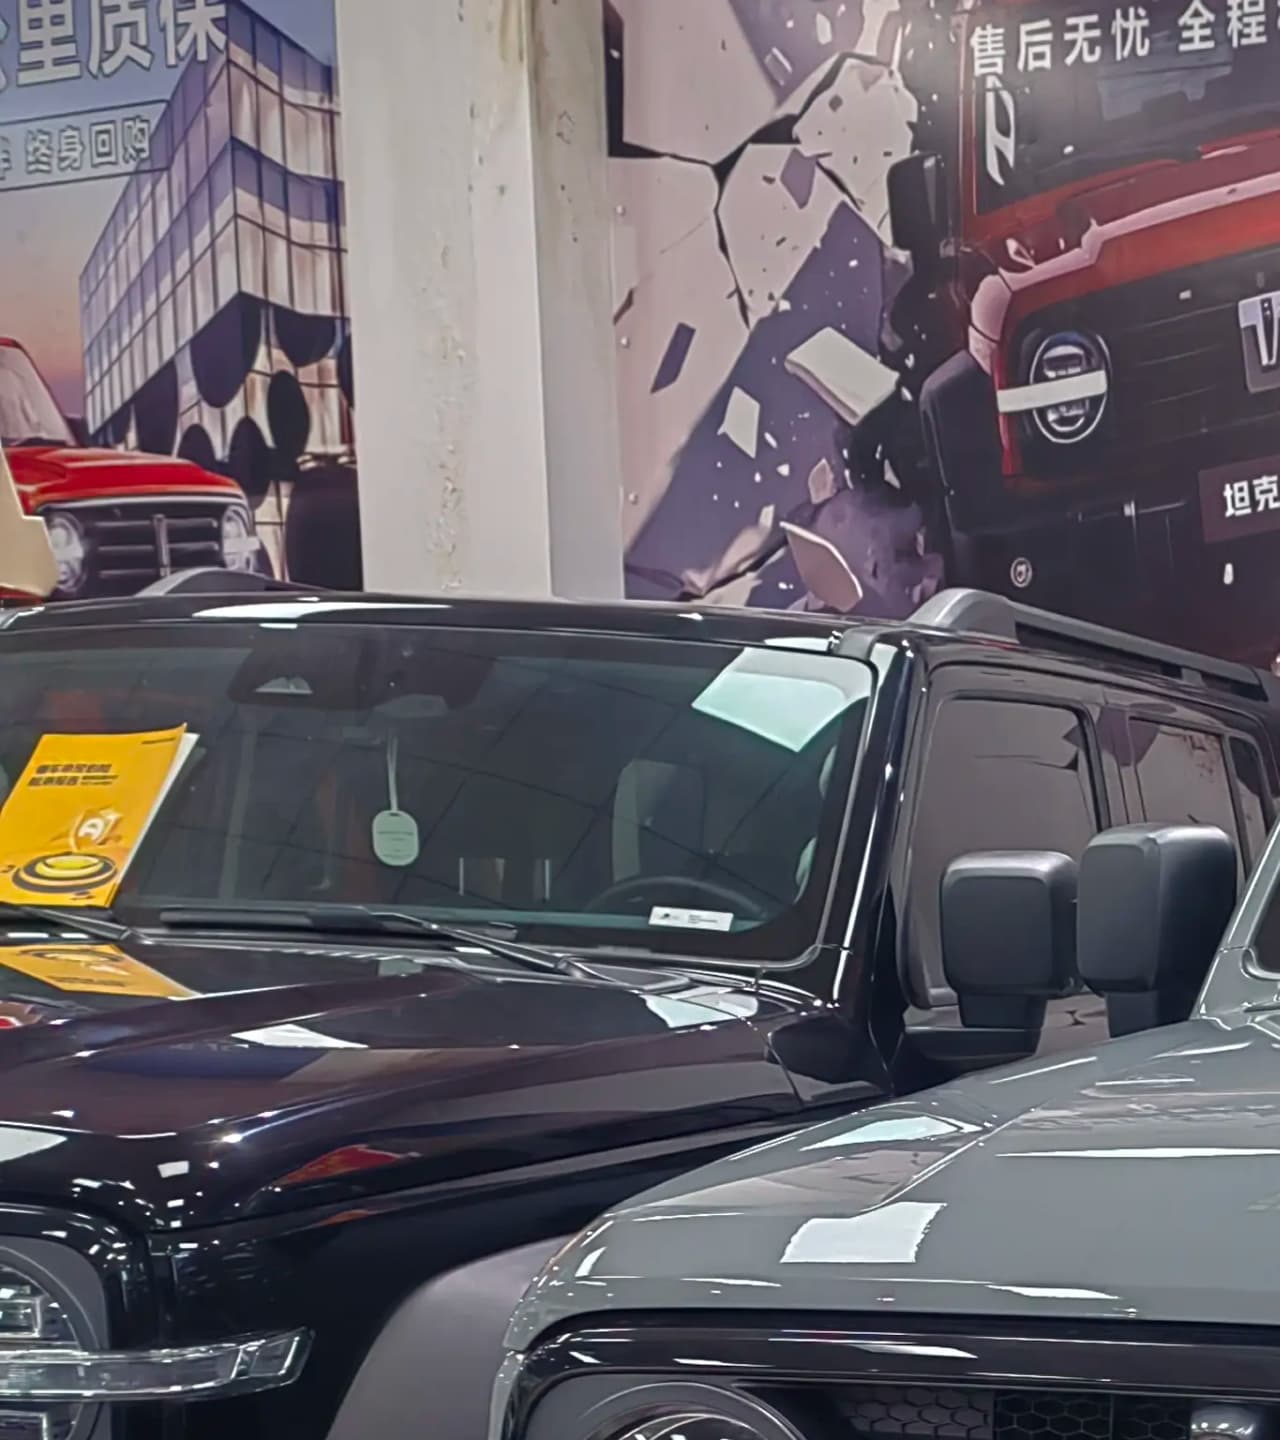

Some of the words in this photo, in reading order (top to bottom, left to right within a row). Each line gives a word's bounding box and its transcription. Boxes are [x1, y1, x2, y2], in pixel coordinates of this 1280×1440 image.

[0, 0, 228, 91] 里质保
[970, 8, 1151, 77] 售后无忧
[26, 115, 150, 174] 终身回购
[1222, 475, 1280, 518] 坦克
